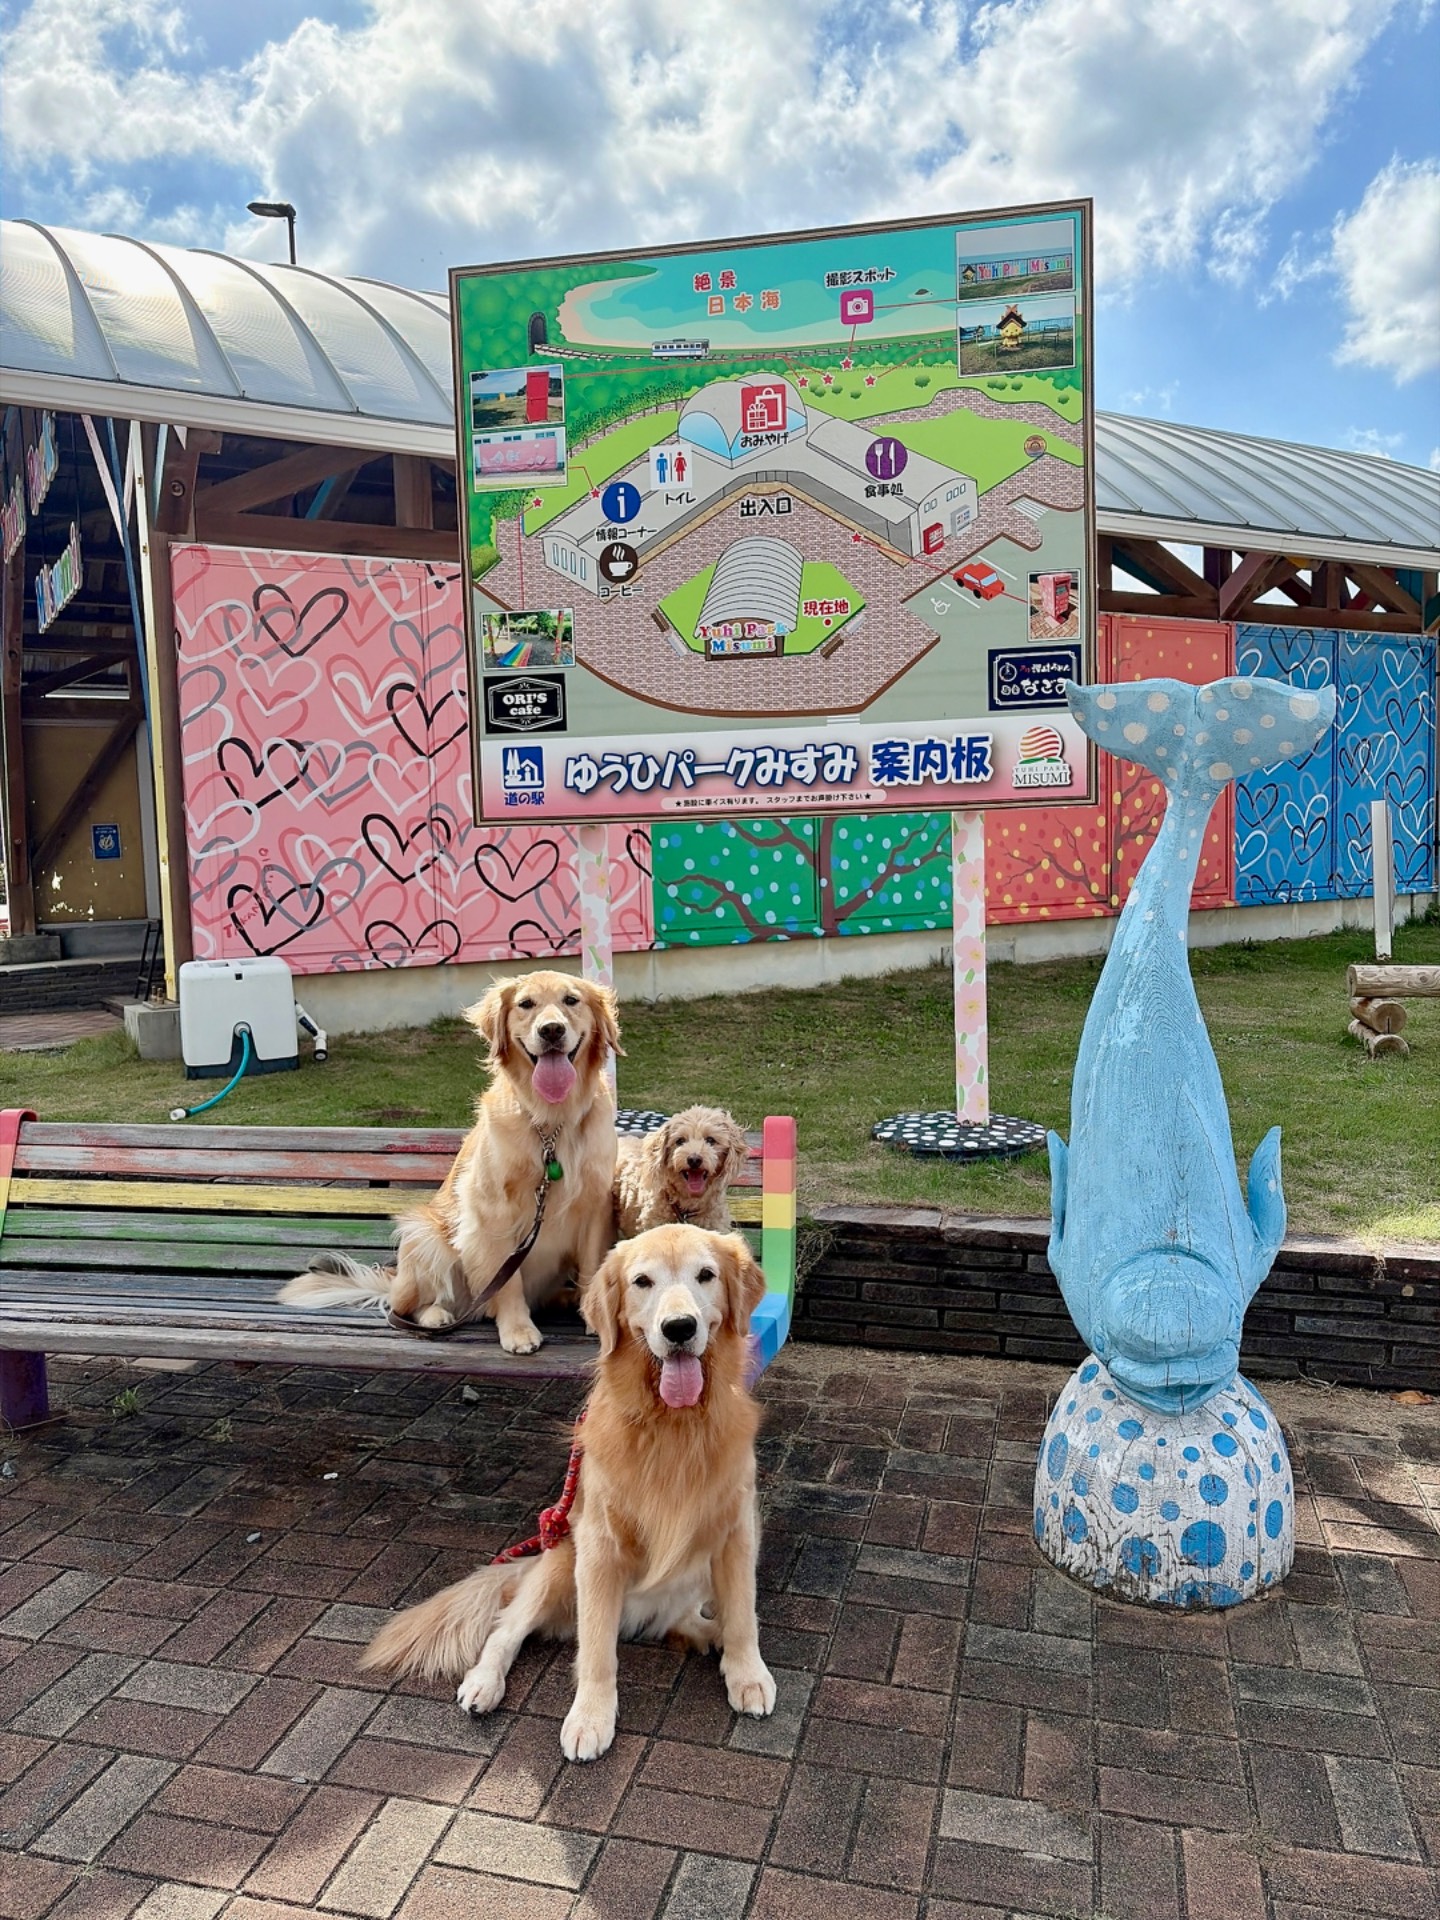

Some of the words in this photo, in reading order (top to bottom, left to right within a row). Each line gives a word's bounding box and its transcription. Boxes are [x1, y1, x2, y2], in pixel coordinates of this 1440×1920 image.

[693, 270, 736, 291] 絶景
[825, 267, 895, 287] 撮影スポット
[708, 290, 780, 315] 日本海
[740, 432, 789, 448] おみやげ
[665, 491, 697, 506] トイレ
[864, 483, 903, 498] 食事処
[740, 497, 793, 518] 出入口
[595, 526, 658, 542] 情報コーナー
[600, 585, 644, 598] コーヒー
[803, 600, 850, 616] 現在地
[699, 623, 741, 638] Yuhi
[746, 621, 789, 637] Park
[711, 637, 774, 653] Misumi
[502, 692, 548, 705] ORI'S
[509, 704, 542, 716] cafe
[565, 743, 858, 794] ゆうひパークみすみ
[871, 734, 993, 785] 案内板
[1014, 772, 1068, 785] MISUMI
[504, 791, 545, 806] 道の駅
